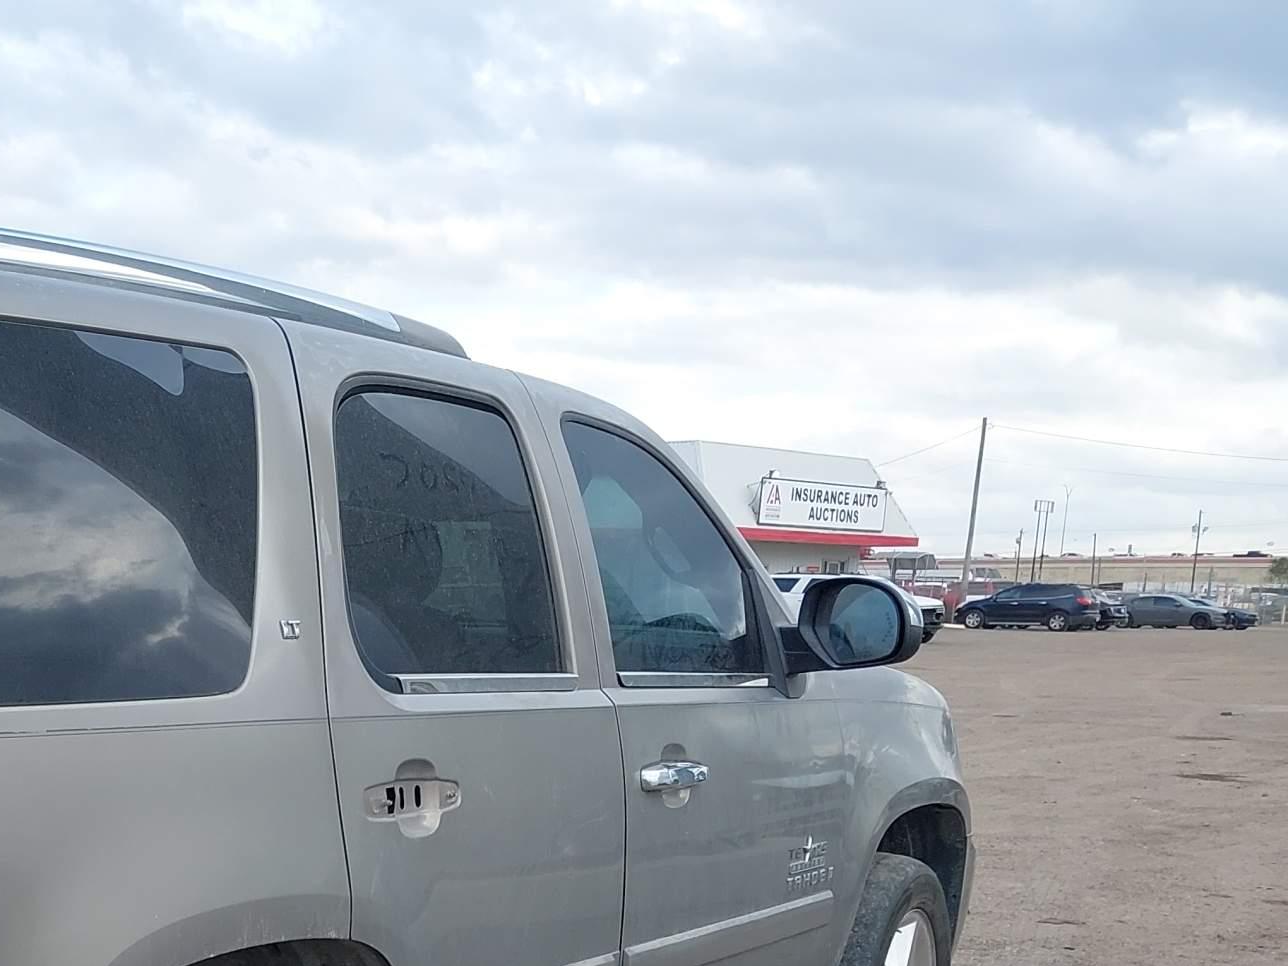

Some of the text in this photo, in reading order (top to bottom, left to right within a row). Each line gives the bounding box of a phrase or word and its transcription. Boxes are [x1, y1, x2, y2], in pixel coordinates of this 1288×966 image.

[791, 487, 878, 508] INSURANCE AUTO
[808, 506, 859, 523] AUCTIONS
[279, 620, 301, 639] LT
